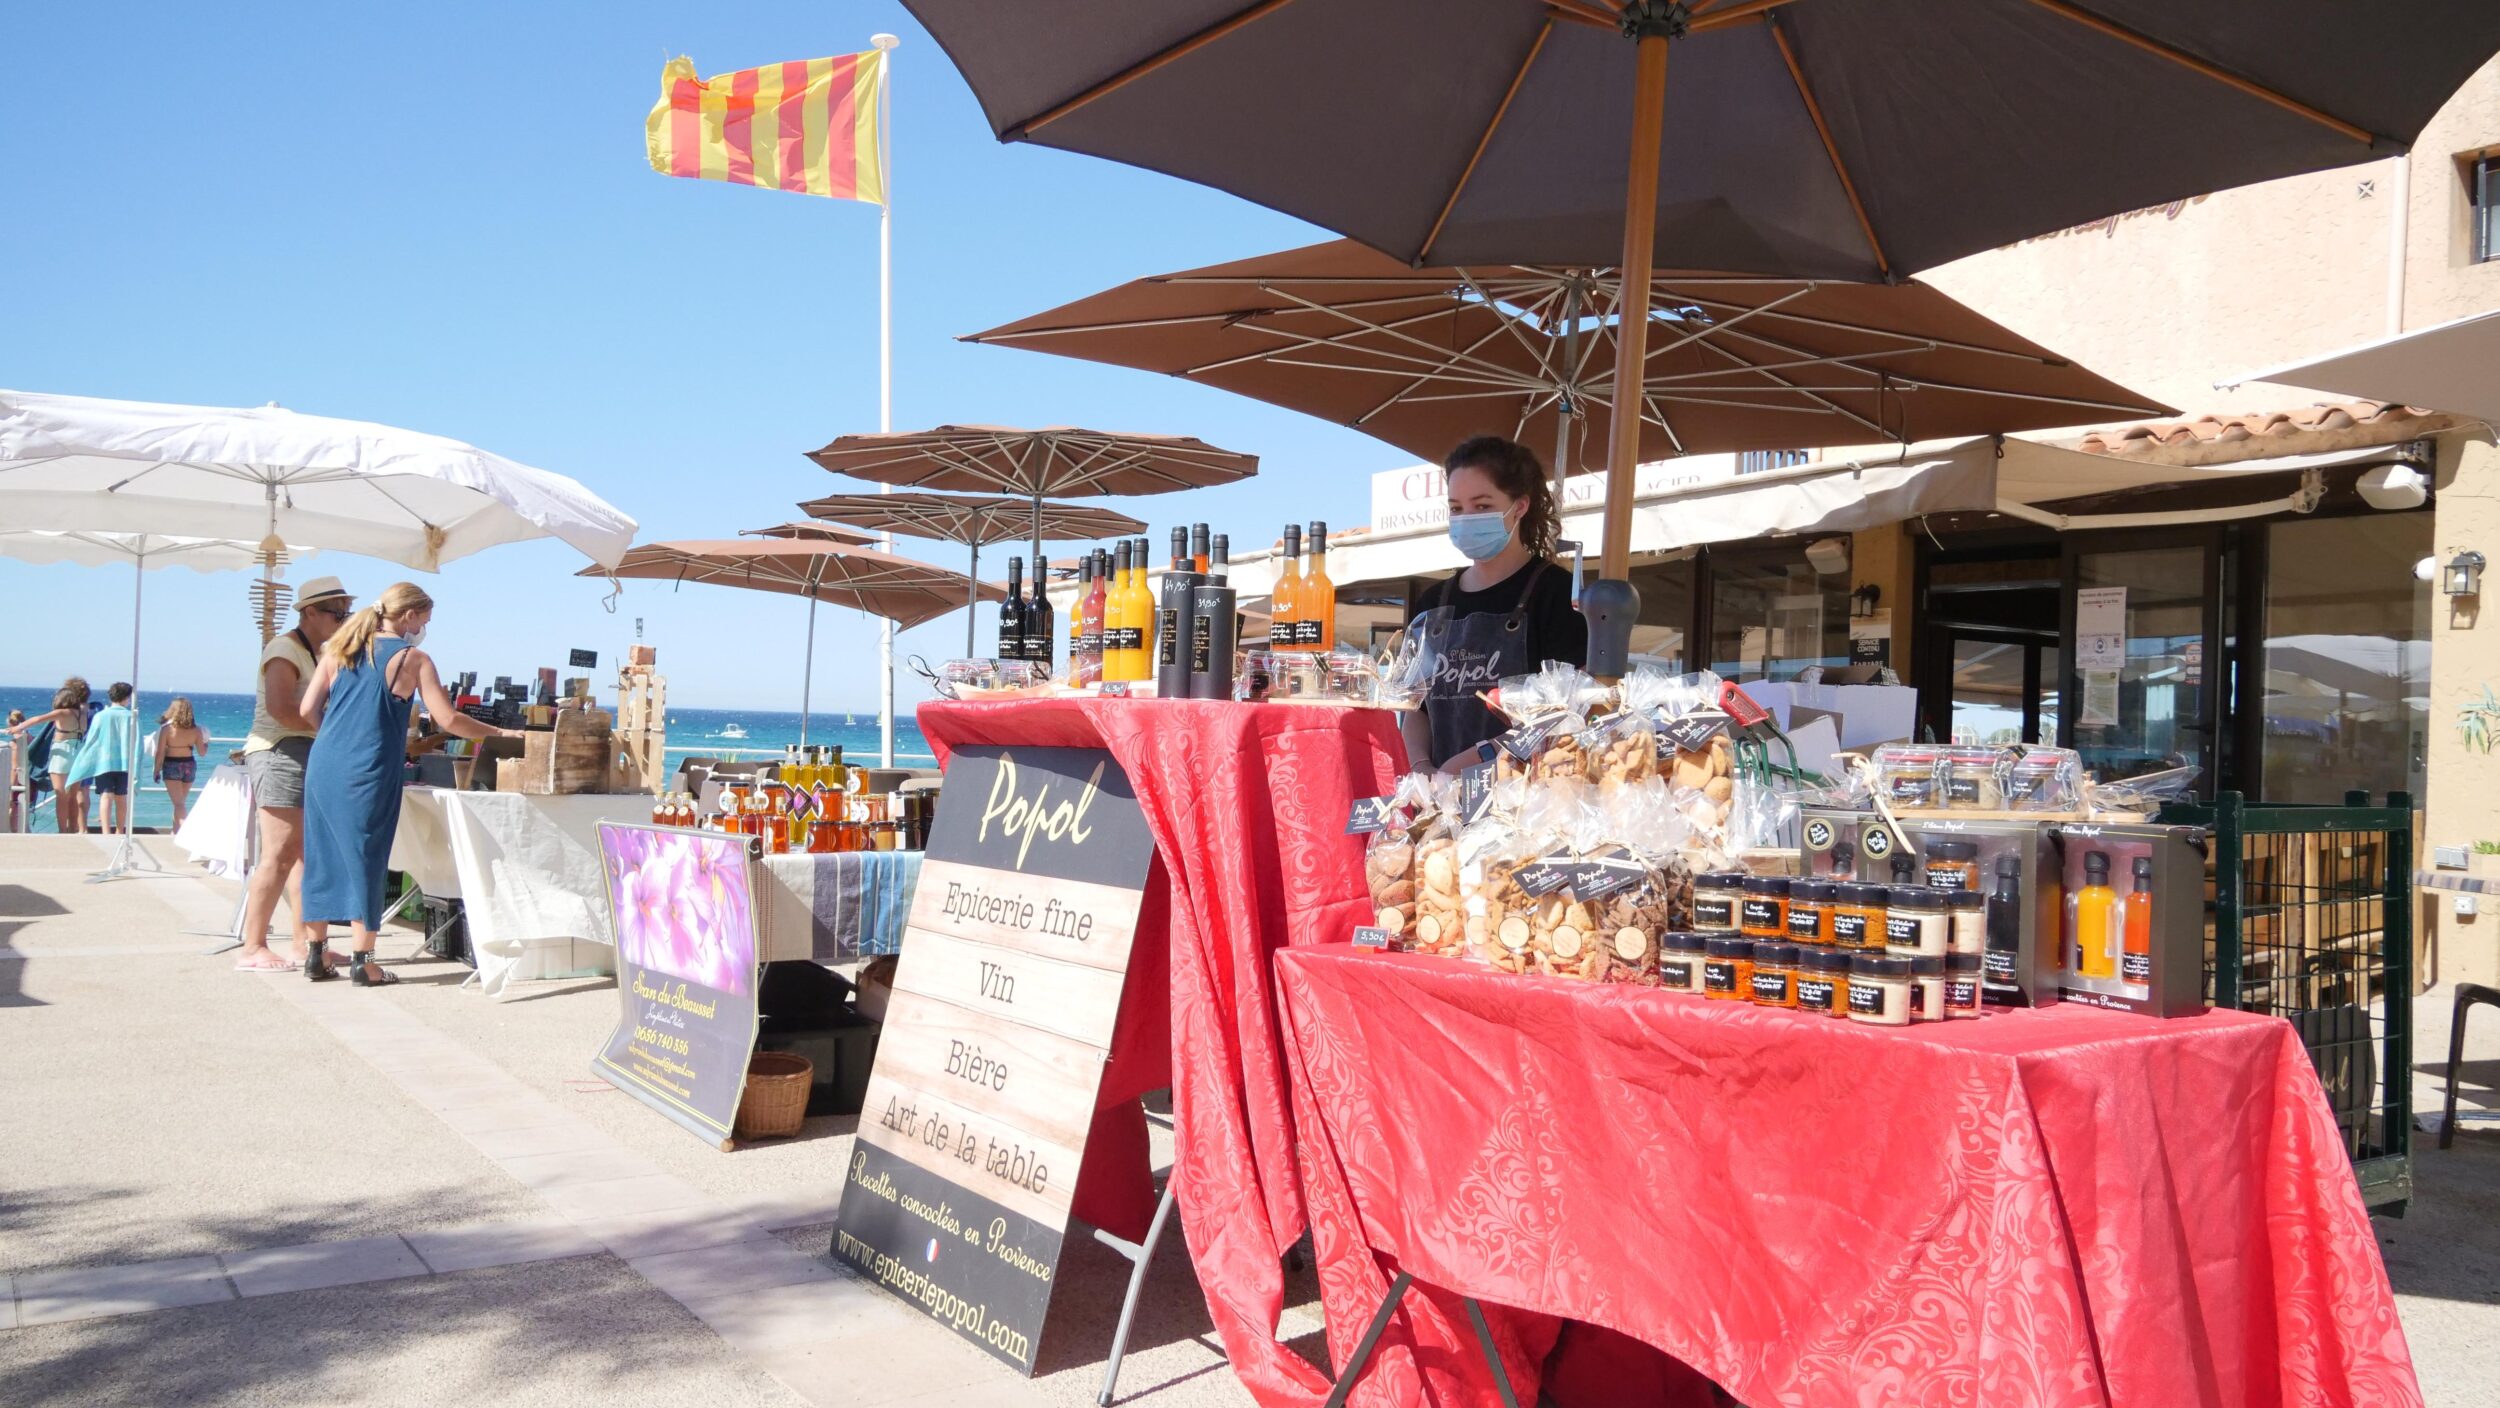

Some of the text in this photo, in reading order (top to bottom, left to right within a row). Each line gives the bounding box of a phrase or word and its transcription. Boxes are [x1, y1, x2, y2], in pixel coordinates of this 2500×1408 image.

[1381, 507, 1448, 530] BRASSERI
[1431, 650, 1501, 693] Popol
[979, 751, 1105, 871] Popol
[1522, 864, 1552, 883] Popol
[1577, 864, 1607, 884] Popol
[942, 881, 1093, 942] Epicerie fine
[658, 981, 672, 1005] du
[671, 983, 716, 1020] Beausset
[980, 960, 1015, 1004] Vin
[944, 1038, 1007, 1092] Bière
[880, 1095, 1048, 1195] Art de la table
[851, 1150, 1051, 1282] Recettes concoctées en Provence
[838, 1229, 1029, 1364] www.epiceriepopol.com
